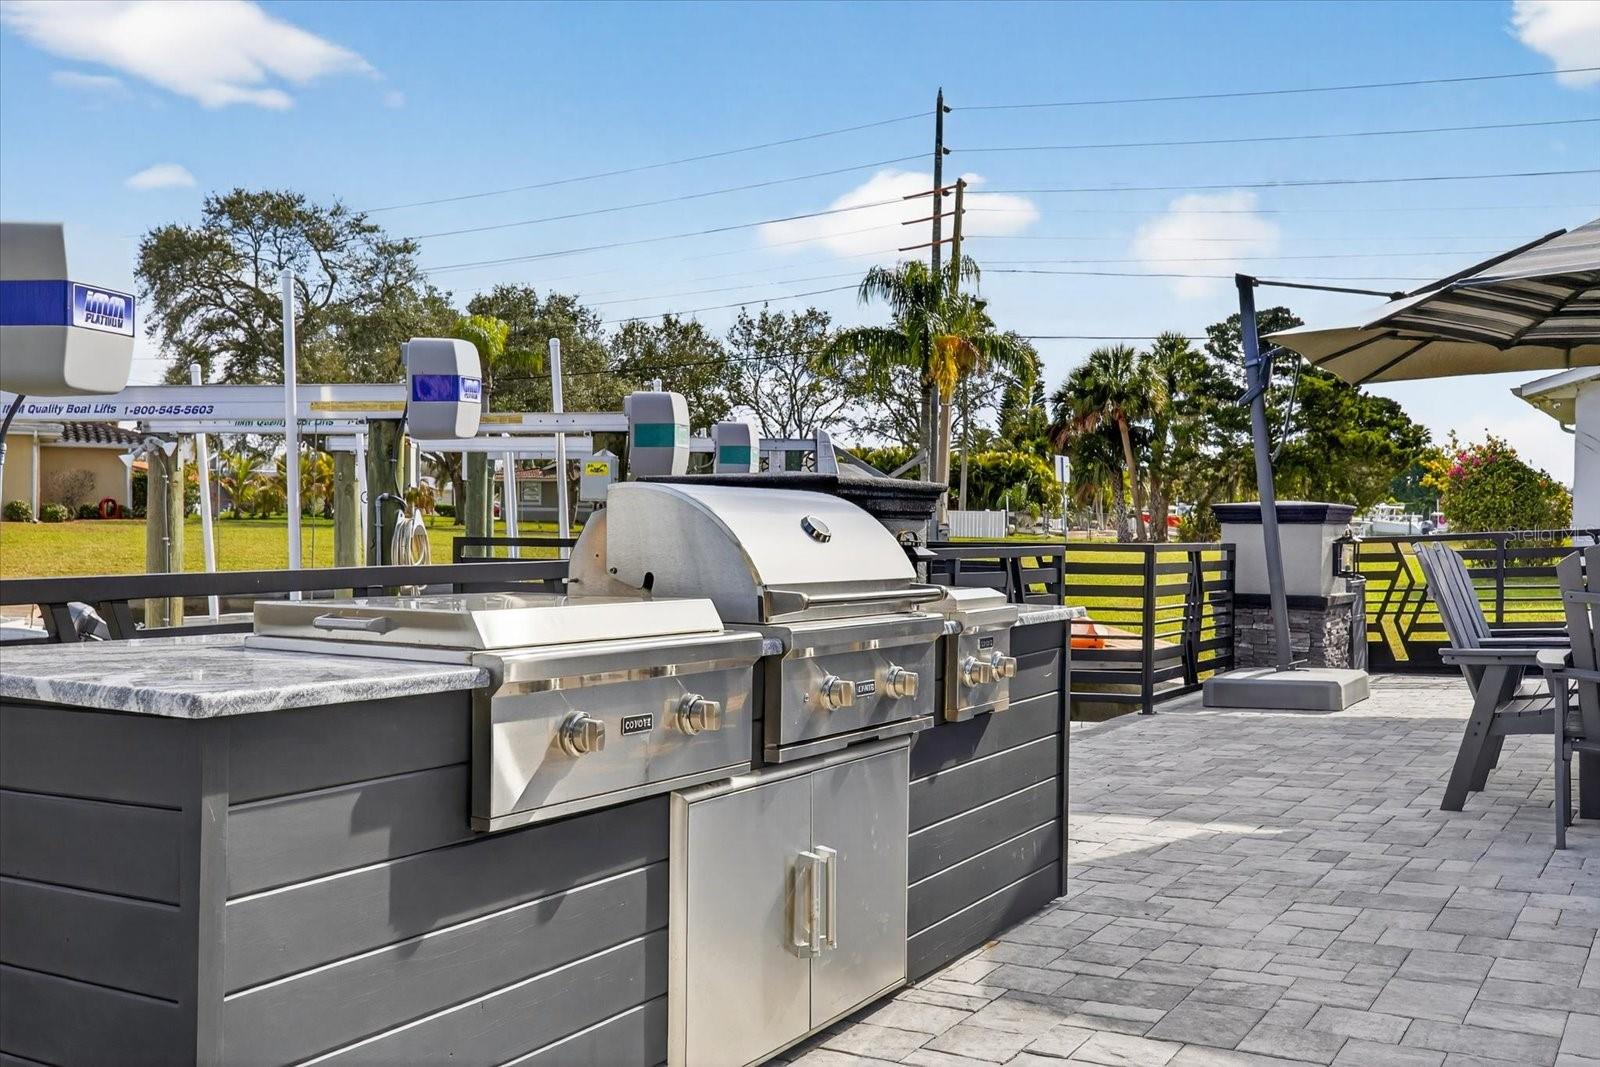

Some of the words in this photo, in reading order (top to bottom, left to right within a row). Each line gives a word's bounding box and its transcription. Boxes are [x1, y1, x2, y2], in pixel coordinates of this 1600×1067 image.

[85, 312, 124, 329] PLATINUM
[27, 404, 64, 416] Quality
[66, 404, 91, 414] Boat
[93, 403, 117, 414] Lifts
[124, 405, 215, 415] 1-800-545-5603
[625, 717, 651, 730] COYOTE
